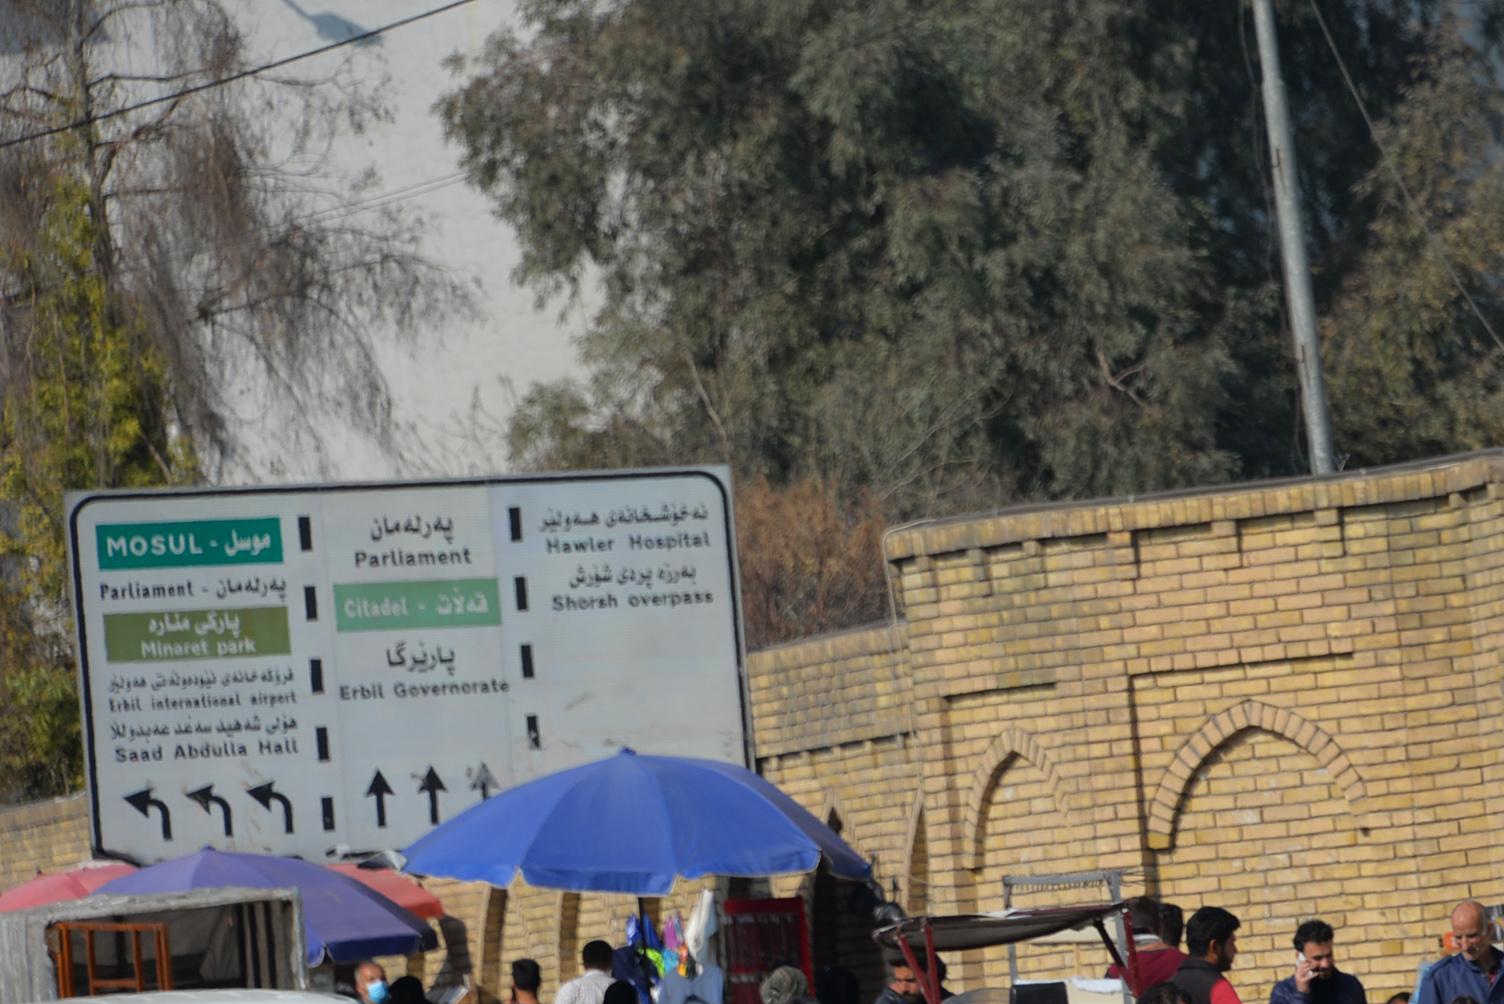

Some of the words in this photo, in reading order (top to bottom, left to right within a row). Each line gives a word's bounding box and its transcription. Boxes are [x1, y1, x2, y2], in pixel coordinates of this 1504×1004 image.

[106, 533, 203, 557] MOSUL
[224, 528, 272, 557] موسل
[546, 535, 615, 554] Hawler
[629, 531, 711, 550] Hospital
[354, 548, 472, 568] Parliament
[99, 580, 195, 600] Parliament
[552, 594, 619, 611] Shorsh
[628, 591, 714, 609] overpass
[343, 596, 407, 618] Citadel
[141, 638, 210, 658] Minaret
[217, 637, 256, 656] park
[339, 684, 384, 702] Erbil
[393, 678, 511, 698] Governorate
[109, 697, 143, 713] Erbil
[151, 694, 241, 711] international
[250, 690, 297, 708] airport
[115, 744, 163, 763] Saad
[174, 740, 248, 760] Abdulla
[258, 737, 299, 756] Hall
